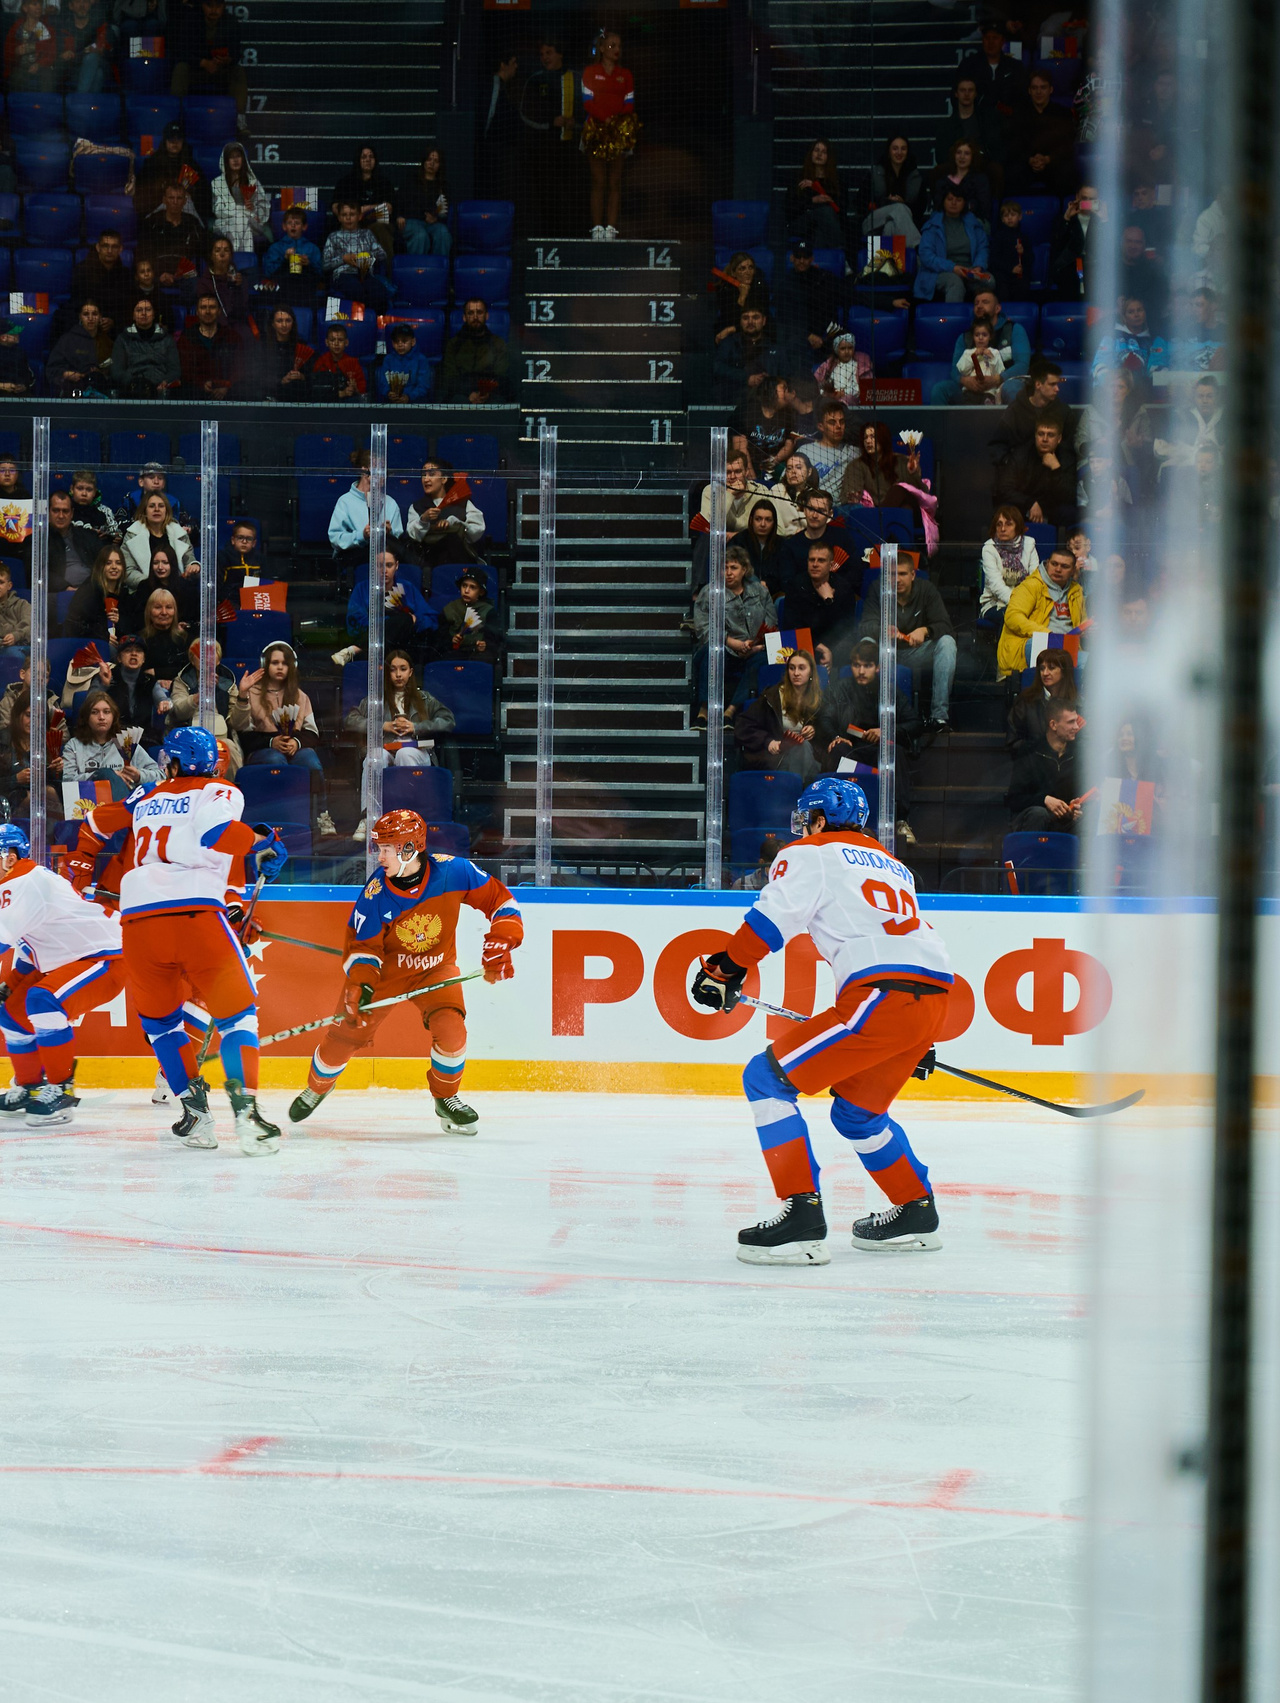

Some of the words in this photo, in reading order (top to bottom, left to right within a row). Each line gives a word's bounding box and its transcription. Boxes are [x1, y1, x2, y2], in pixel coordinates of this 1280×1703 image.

[255, 143, 280, 162] 16
[535, 248, 561, 268] 14
[646, 247, 673, 268] 14
[528, 300, 555, 322] 13
[648, 300, 676, 322] 13
[525, 359, 552, 381] 12
[647, 359, 674, 381] 12
[650, 419, 672, 445] 11
[397, 952, 444, 970] РОССИЯ
